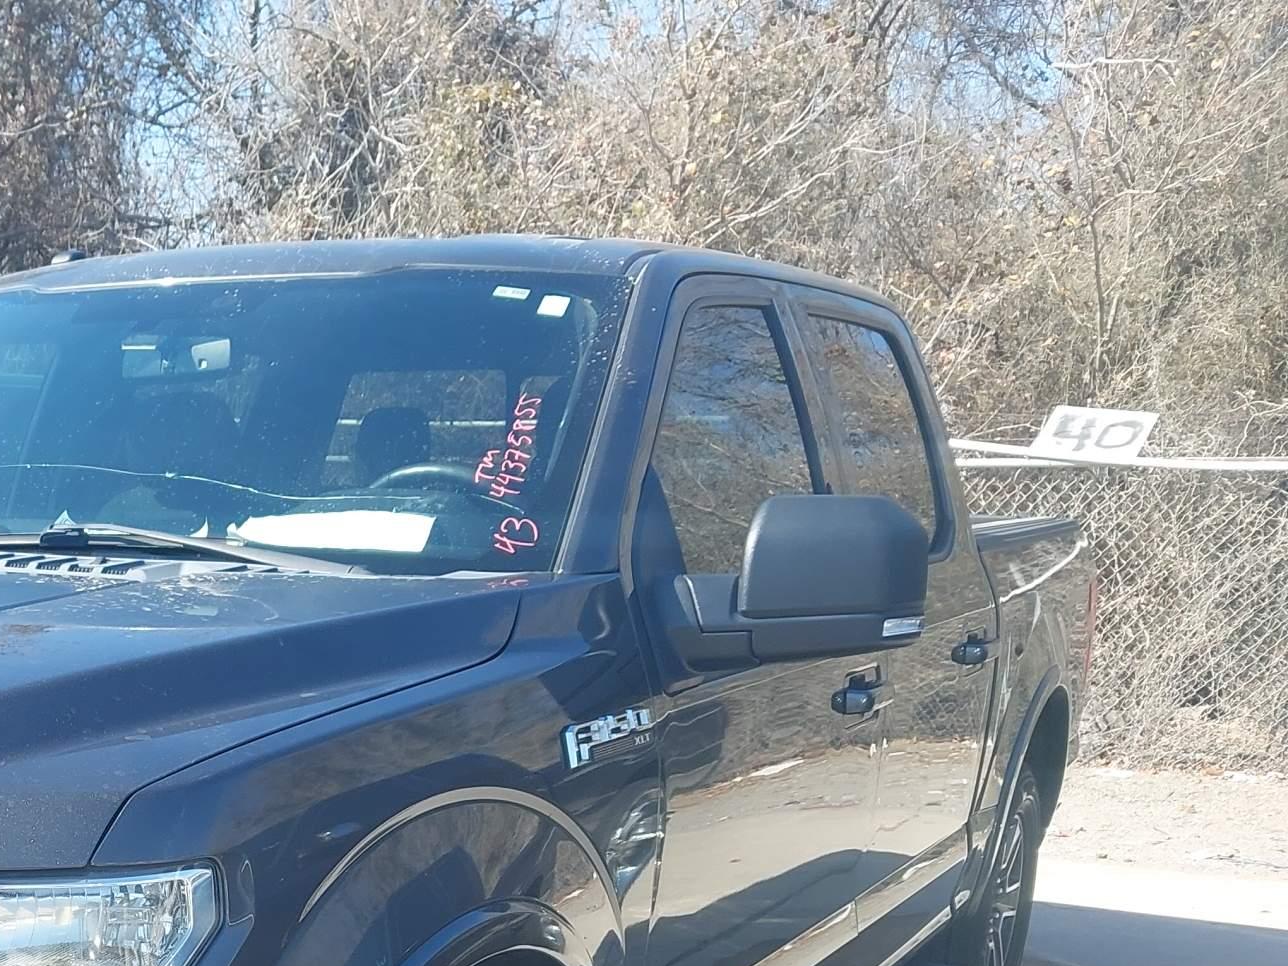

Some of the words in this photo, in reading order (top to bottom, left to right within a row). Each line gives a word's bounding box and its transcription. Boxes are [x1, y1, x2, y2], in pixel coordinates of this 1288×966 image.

[1052, 414, 1145, 452] 40
[494, 517, 539, 554] 43
[634, 733, 651, 746] XLT
